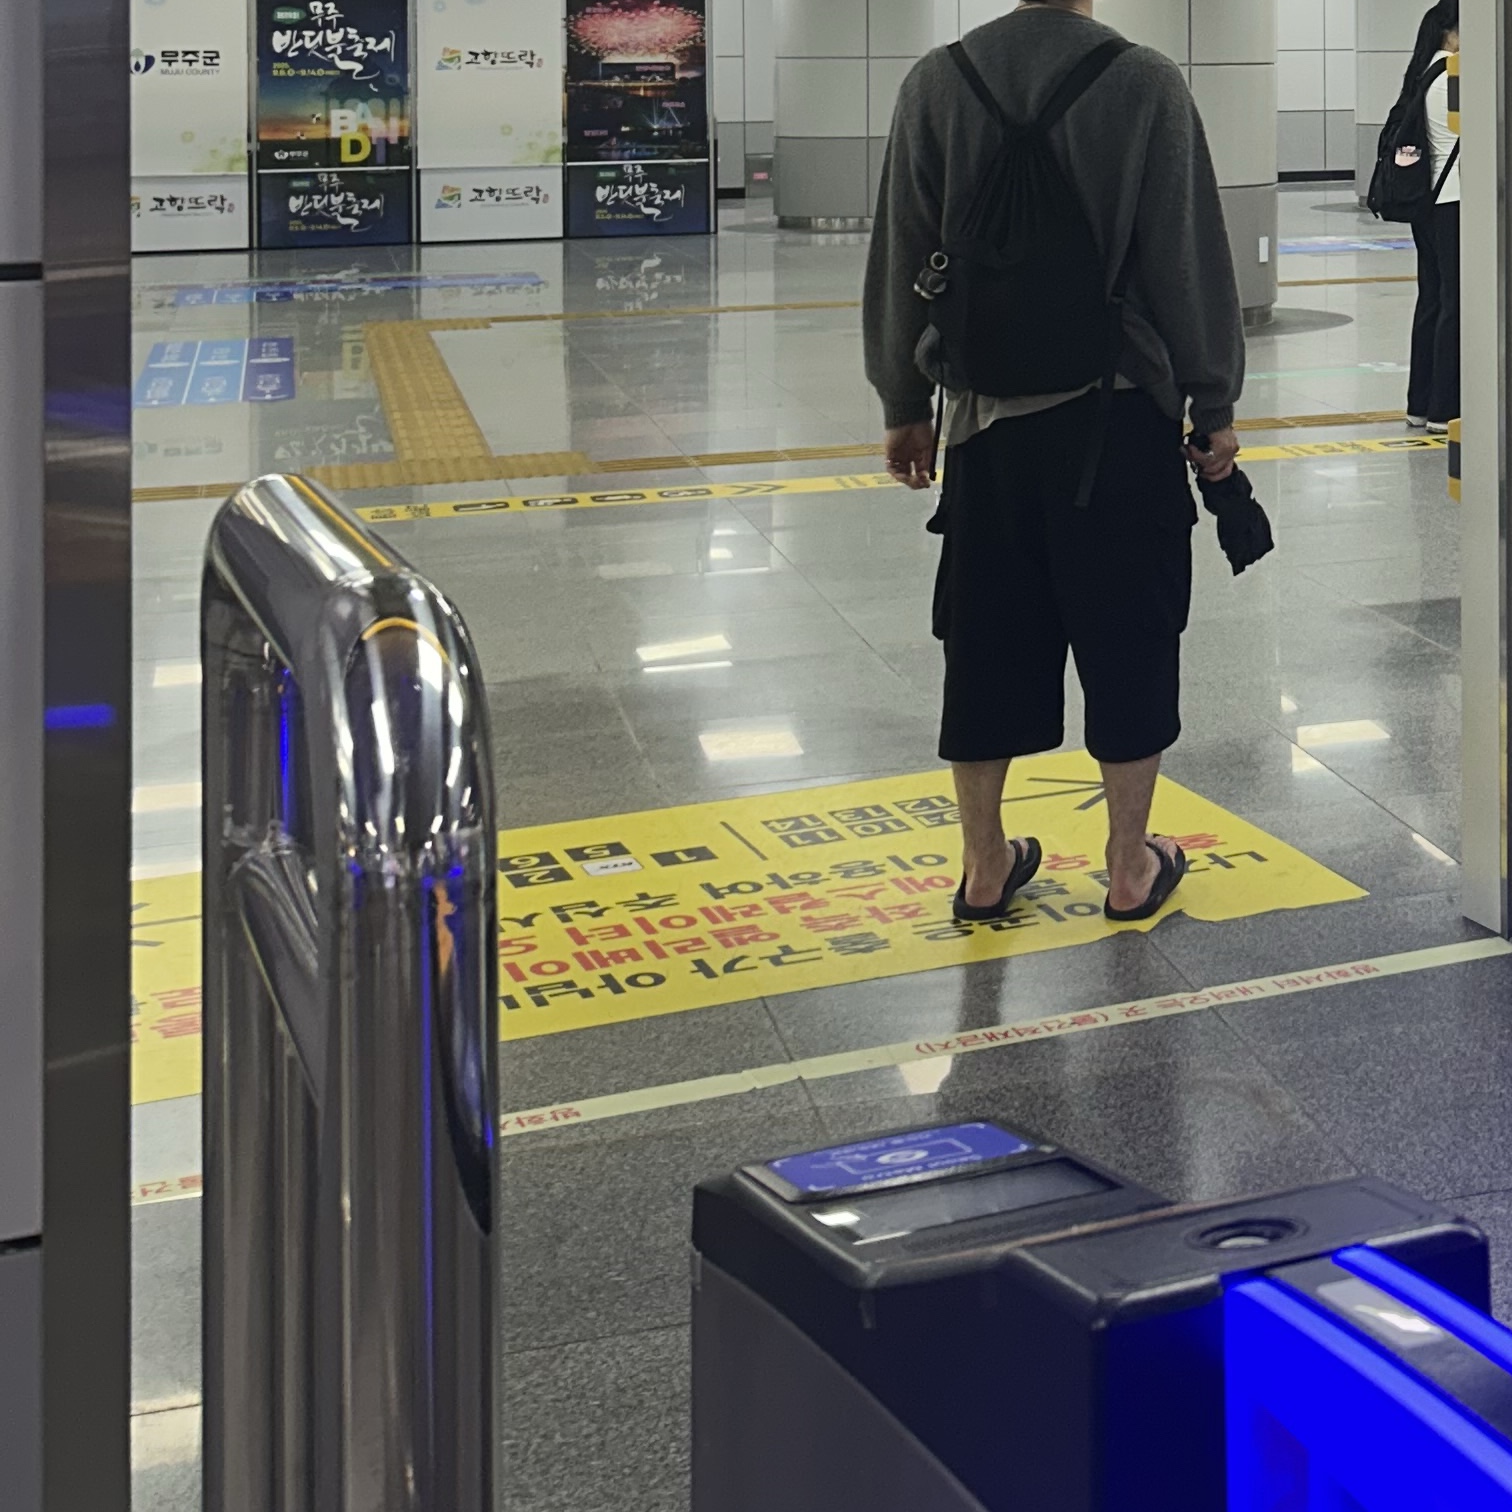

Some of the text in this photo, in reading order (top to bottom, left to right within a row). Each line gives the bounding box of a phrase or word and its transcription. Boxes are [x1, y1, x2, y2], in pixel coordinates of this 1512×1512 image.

[308, 0, 345, 30] 무주
[161, 50, 220, 67] 무주군
[272, 27, 396, 81] 반딧불축제
[767, 795, 952, 833] 12 13 14
[852, 819, 907, 837] 10
[788, 828, 839, 846] 11
[508, 844, 611, 870] 5 6
[522, 869, 556, 884] 2
[499, 853, 948, 933] 이용하여 주십시
[564, 875, 956, 947] 에스컬레이터
[800, 902, 932, 933] 좌측
[503, 924, 781, 983] 엘리베이
[690, 931, 892, 979] 출구가
[1122, 1005, 1149, 1020] 곳
[499, 1107, 582, 1131] 방화
